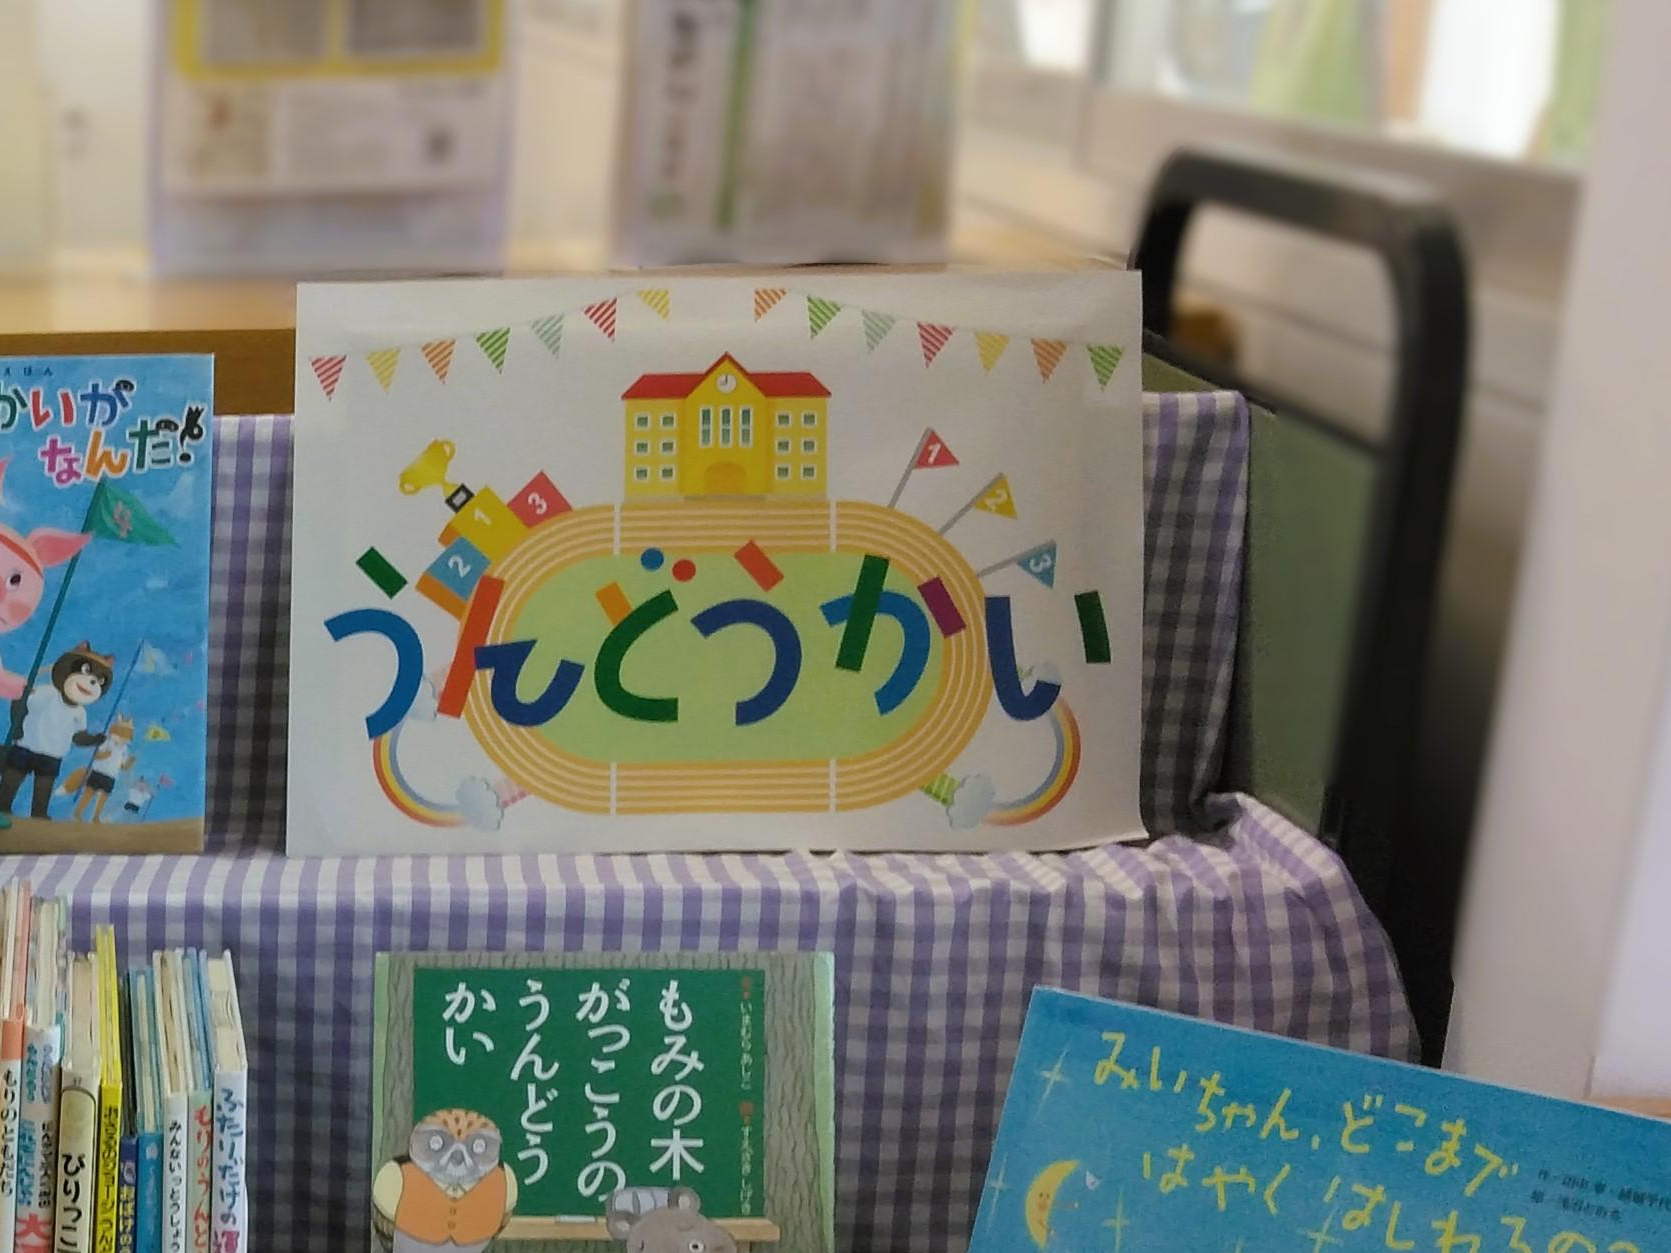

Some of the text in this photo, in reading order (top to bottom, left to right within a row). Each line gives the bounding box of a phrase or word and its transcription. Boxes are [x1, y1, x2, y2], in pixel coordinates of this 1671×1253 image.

[927, 441, 944, 466] 1
[474, 505, 492, 527] 1
[529, 493, 548, 516] 3
[986, 487, 1010, 508] 2
[447, 552, 471, 580] 2
[1031, 553, 1053, 576] 3
[324, 540, 1112, 740] うんどうかい
[442, 981, 496, 1065] かい
[509, 978, 559, 1186] うんどう
[575, 977, 631, 1202] がっこうの
[649, 980, 705, 1180] もみの木
[0, 1069, 18, 1198] もりのともだち
[168, 1120, 183, 1250] みんないっとうしょう
